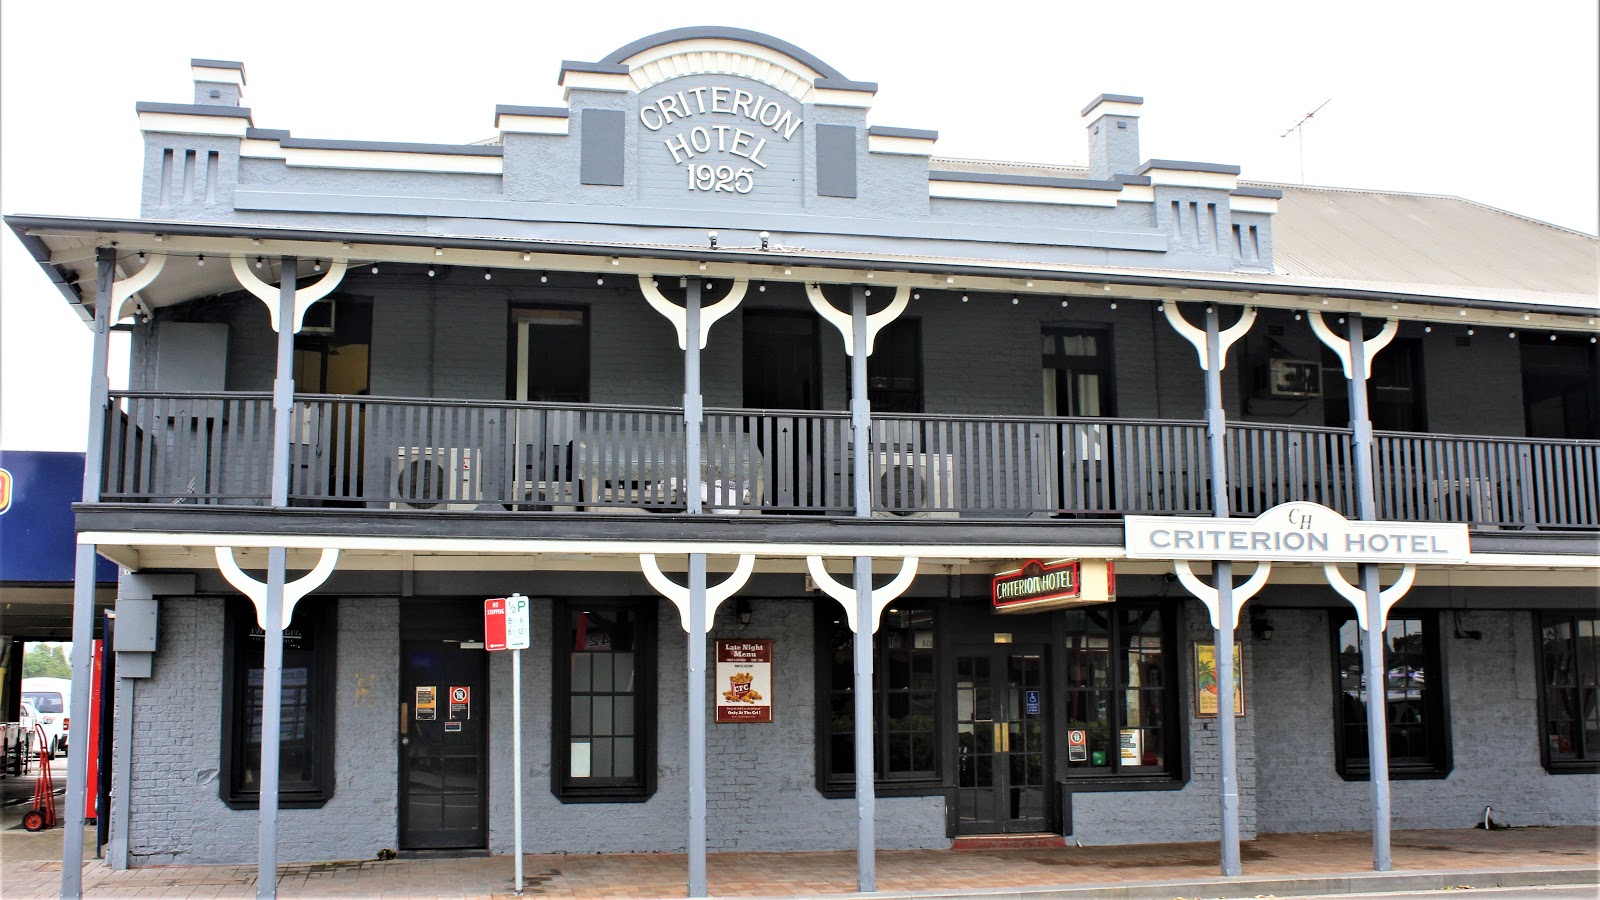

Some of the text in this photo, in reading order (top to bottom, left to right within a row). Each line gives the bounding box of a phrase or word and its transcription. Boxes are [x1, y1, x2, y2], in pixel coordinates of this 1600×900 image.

[640, 86, 803, 141] CRITERION
[664, 125, 767, 168] HOTEL
[687, 163, 754, 194] 1925
[1149, 529, 1449, 553] CRITERION HOTEL
[997, 570, 1073, 599] CRITERION HOTEL
[734, 650, 757, 658] Menu
[742, 644, 763, 652] Night
[735, 684, 749, 693] CFC
